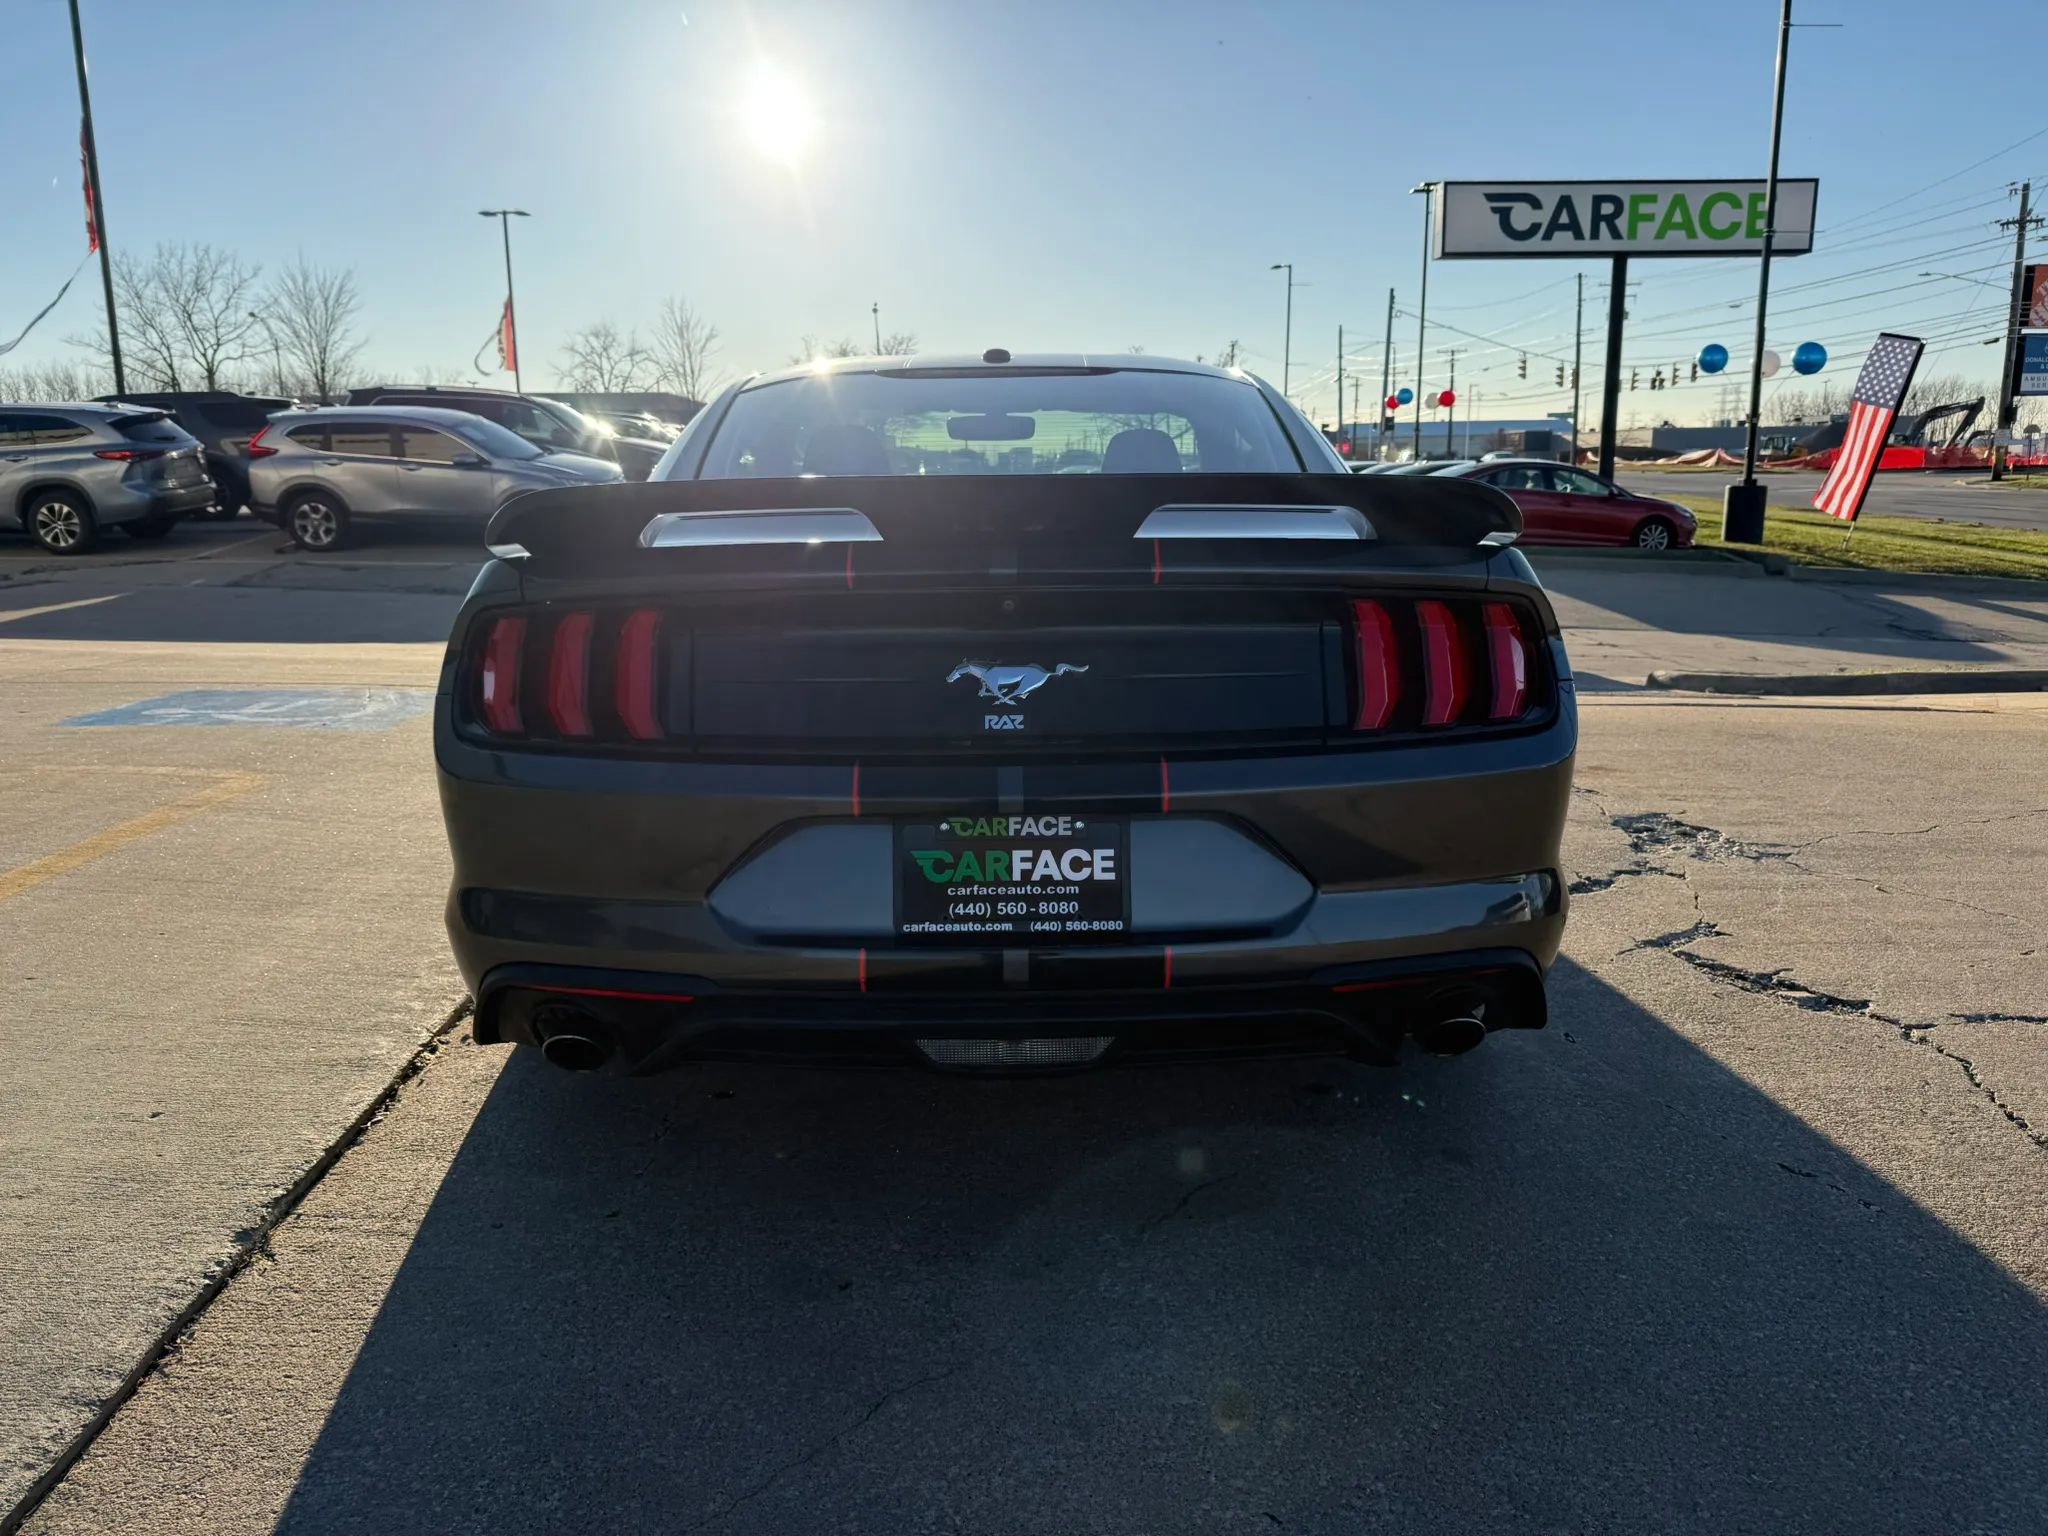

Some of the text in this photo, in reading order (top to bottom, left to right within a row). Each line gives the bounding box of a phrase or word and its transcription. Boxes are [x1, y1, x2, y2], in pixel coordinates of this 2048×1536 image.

[1482, 191, 1769, 241] CARFACE
[949, 816, 1073, 837] CARFACE
[910, 848, 1116, 884] CARFACE
[947, 884, 1080, 896] carfaceauto.com
[948, 902, 991, 918] (440)
[902, 920, 1124, 932] carfaceauto.com (440) 560-8080
